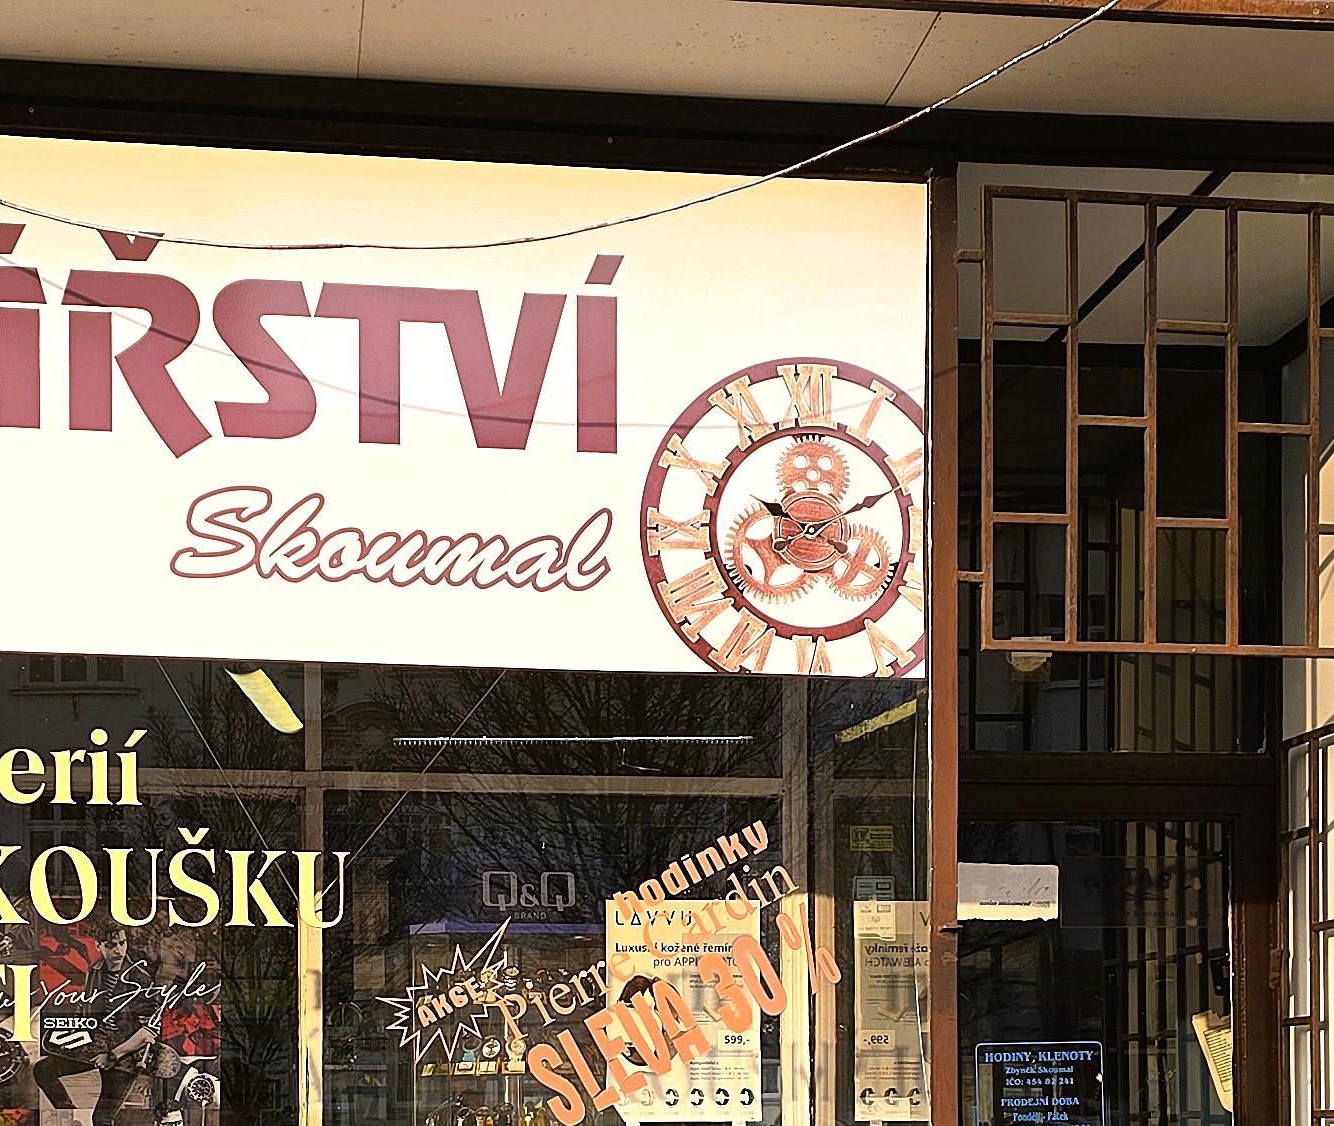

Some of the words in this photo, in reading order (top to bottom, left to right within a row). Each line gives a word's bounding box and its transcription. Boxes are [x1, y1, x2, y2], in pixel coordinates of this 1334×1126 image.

[169, 485, 614, 593] Skoumal
[482, 871, 576, 912] Q&Q
[513, 911, 547, 920] BRAND
[43, 1016, 98, 1030] SEIKO
[416, 977, 484, 1028] AKCE
[527, 981, 713, 1126] SLEVA
[697, 933, 788, 1033] 30
[775, 901, 842, 996] %
[1038, 1050, 1095, 1062] KLENOTY
